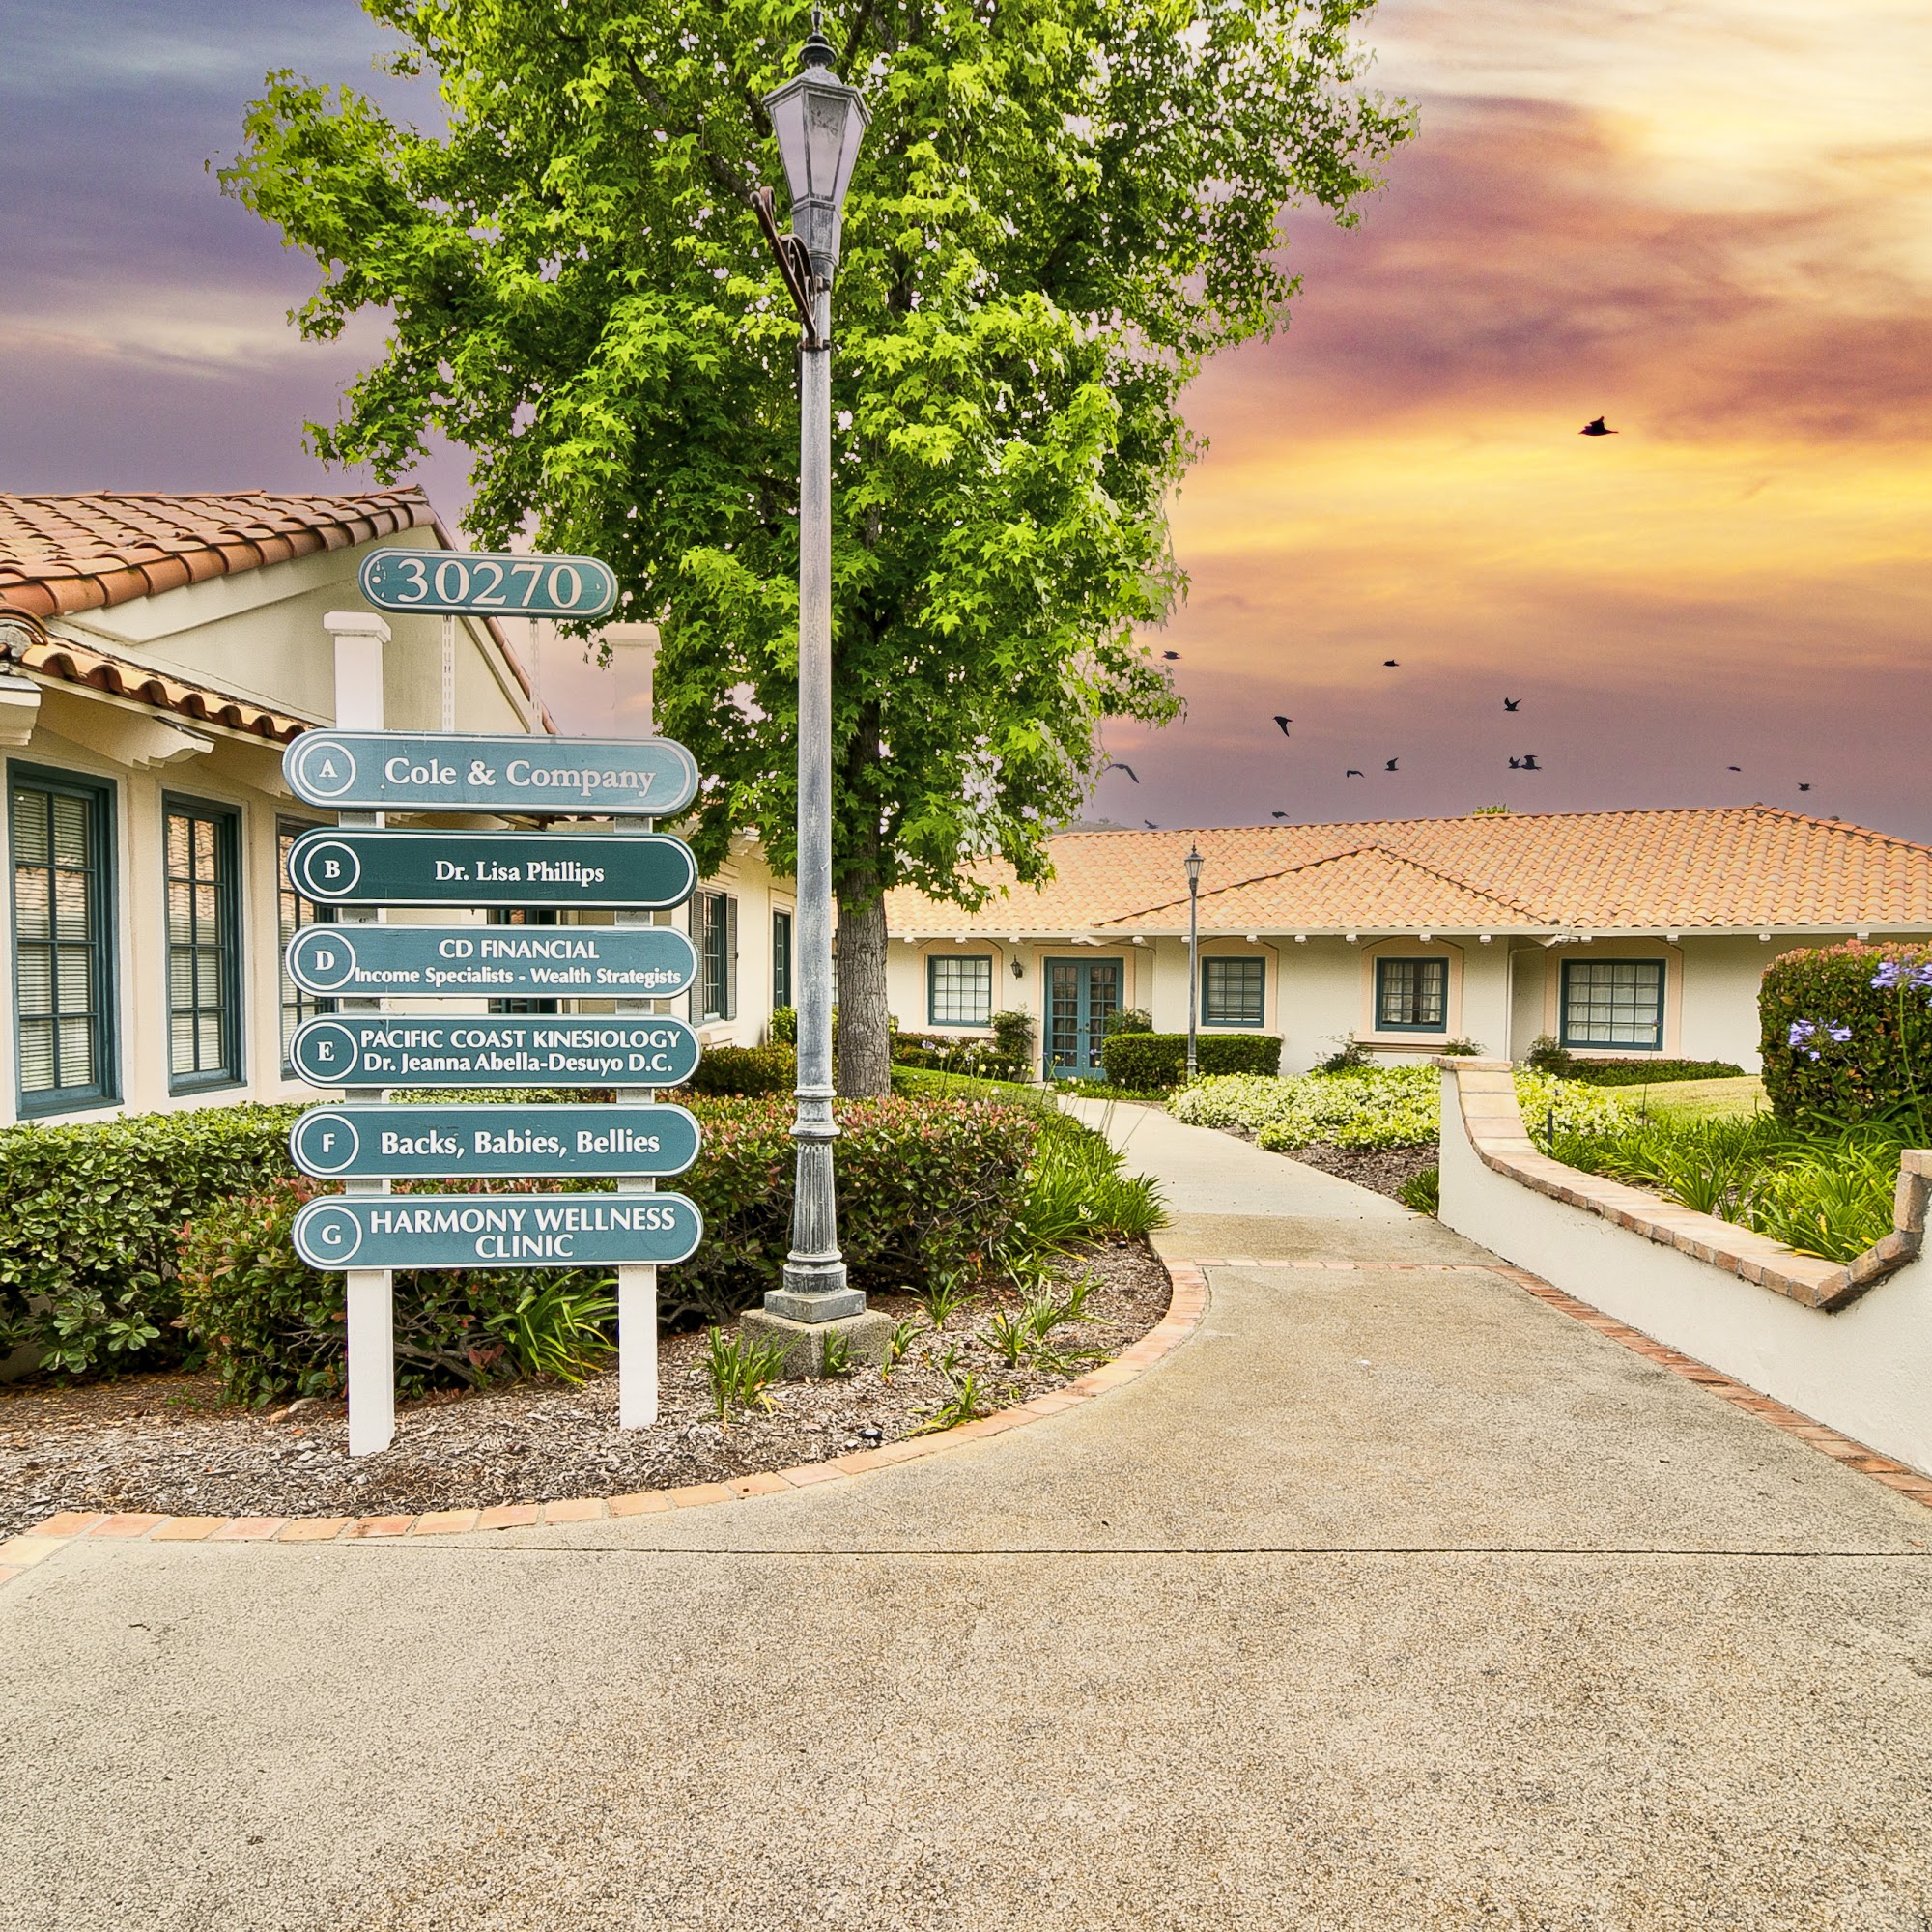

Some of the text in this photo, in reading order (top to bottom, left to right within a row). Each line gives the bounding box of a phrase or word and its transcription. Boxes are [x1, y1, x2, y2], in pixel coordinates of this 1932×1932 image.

[397, 558, 581, 609] 30270
[319, 759, 338, 779] A
[385, 758, 656, 797] Cole & Company
[325, 861, 341, 878] B
[435, 862, 604, 886] Dr. Lisa Phillips
[439, 939, 599, 959] CD FINANCIAL
[315, 951, 335, 970] D
[355, 967, 420, 982] Income
[425, 967, 514, 987] Specialists
[530, 968, 591, 984] Wealth
[597, 968, 681, 988] Strategists
[360, 1030, 681, 1049] PACIFIC COAST KINESIOLOGY
[317, 1041, 335, 1061] E
[364, 1053, 672, 1076] Dr. Jeanna Abella-Desuyo D.C.
[322, 1133, 335, 1152] F
[381, 1130, 660, 1158] Backs, Babies, Bellies
[370, 1208, 675, 1234] HARMONY WELLNESS
[322, 1225, 342, 1245] G
[475, 1234, 574, 1258] CLINIC
